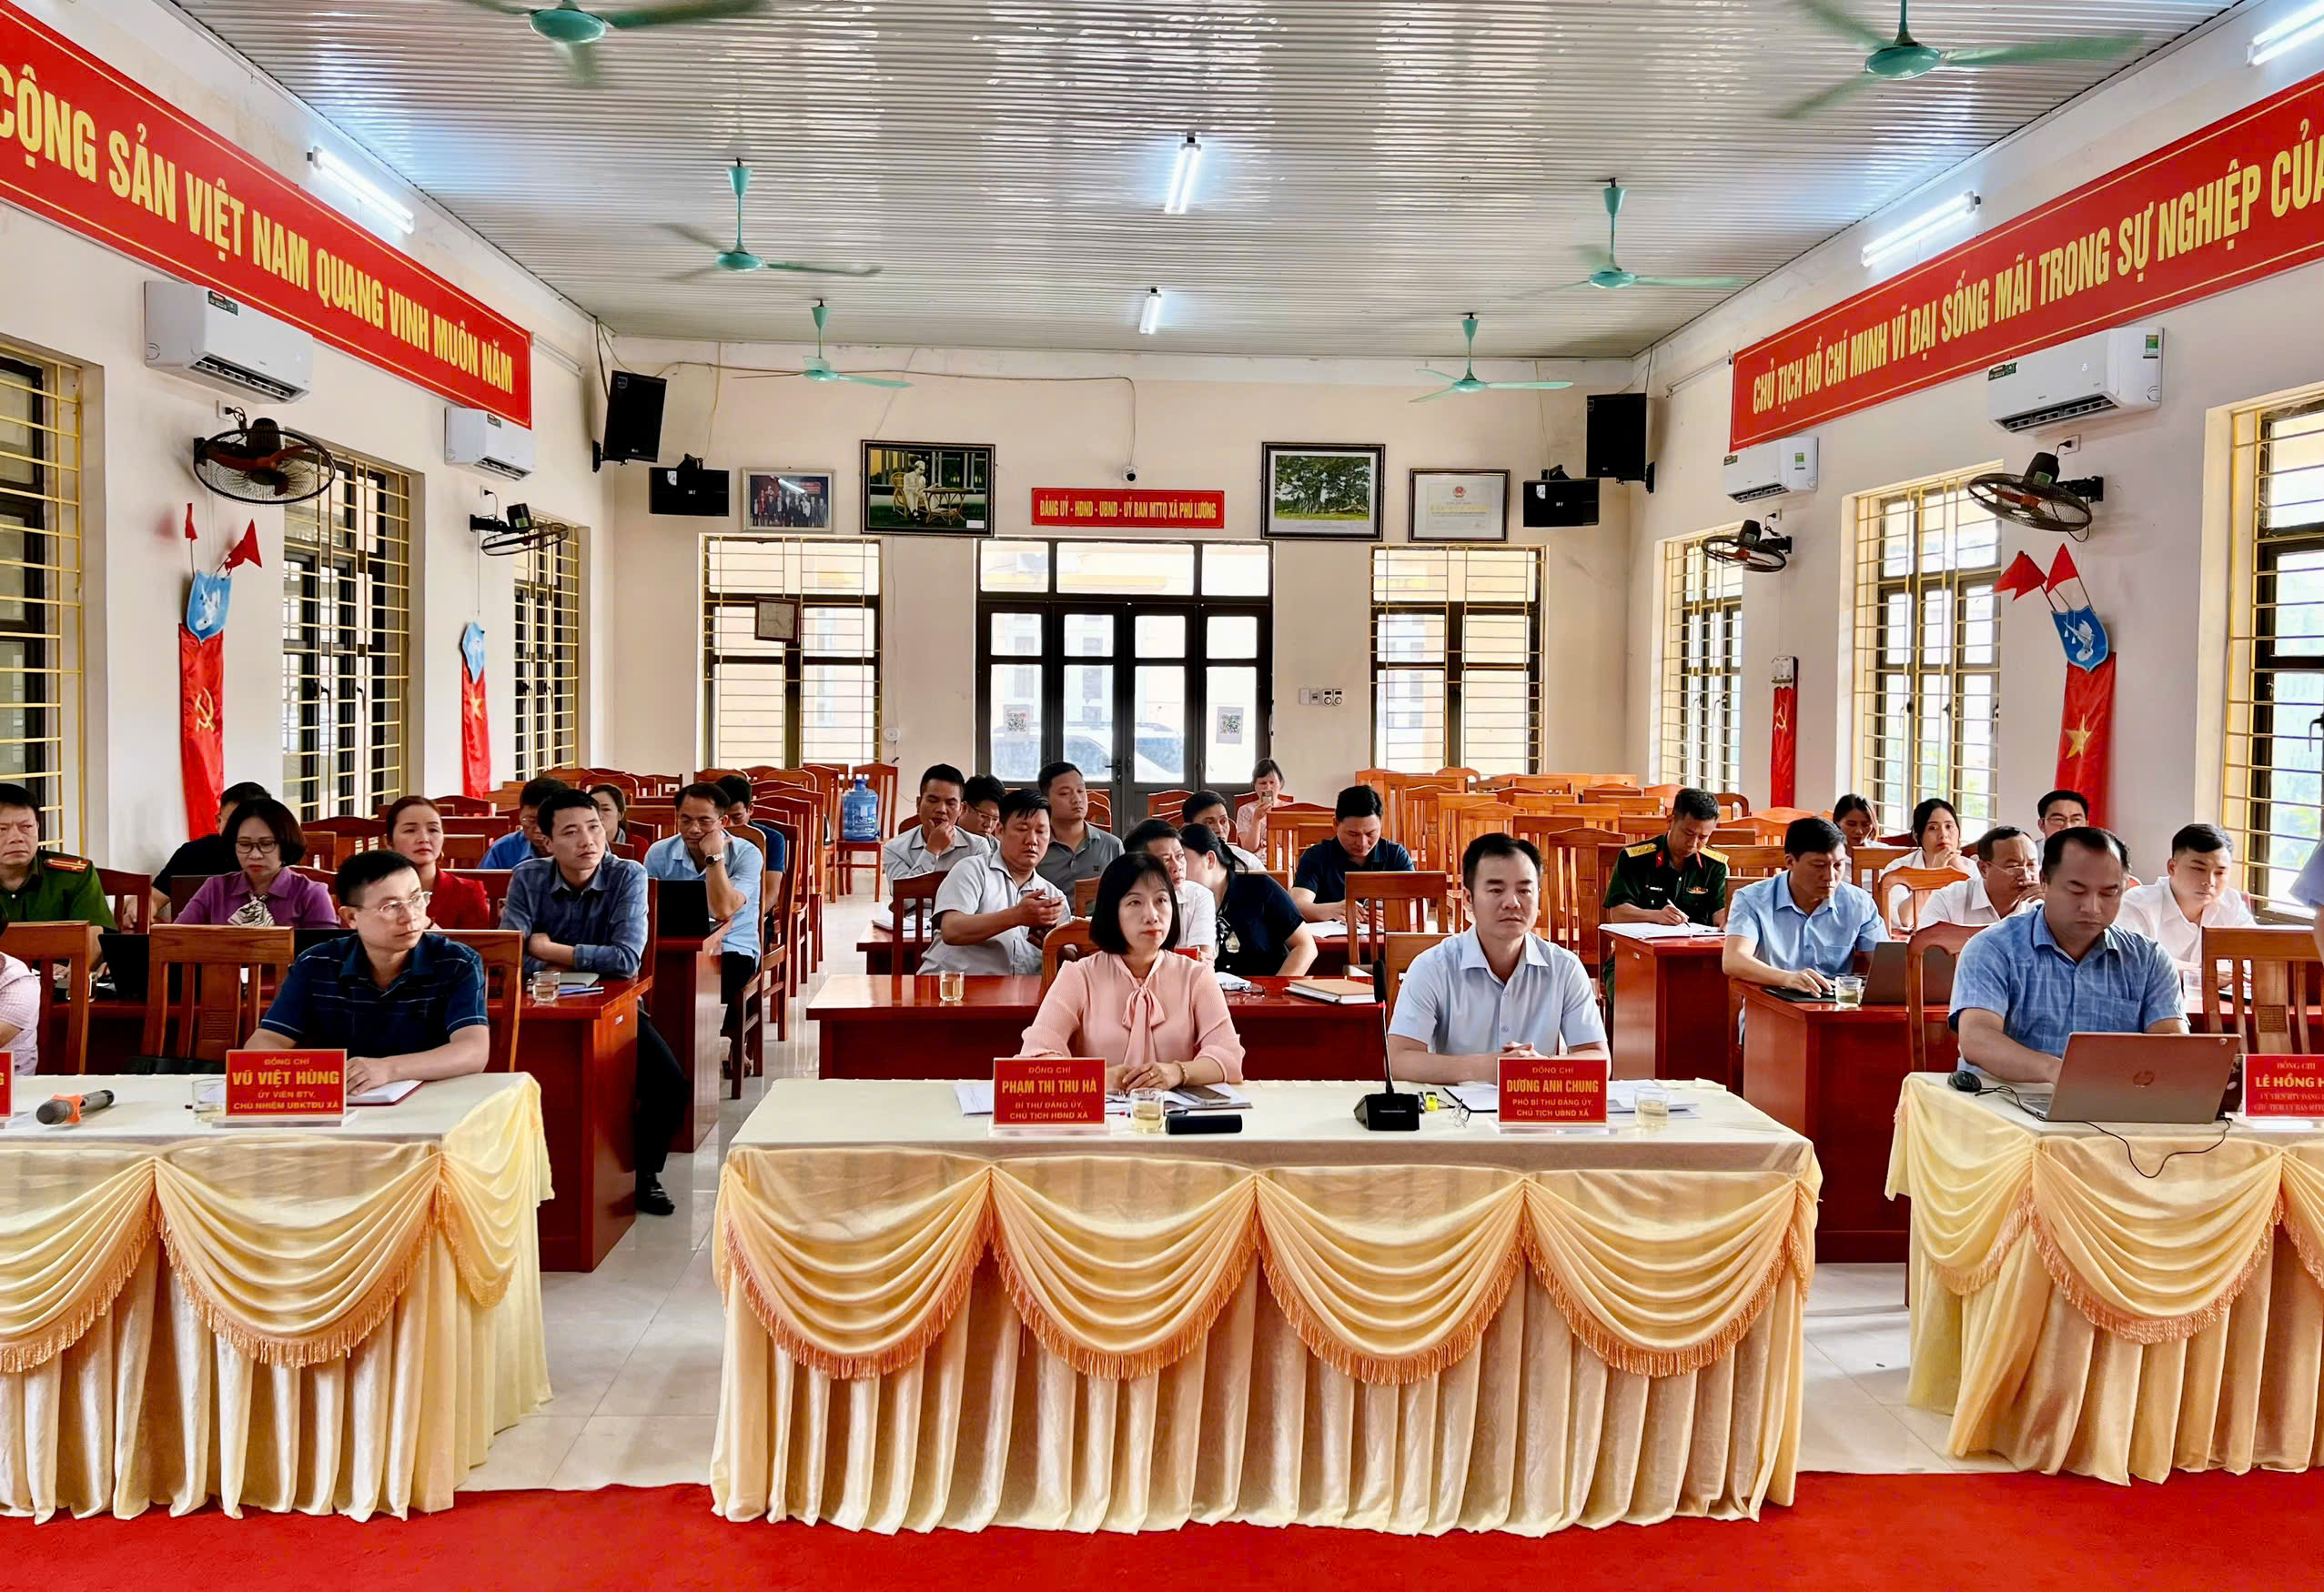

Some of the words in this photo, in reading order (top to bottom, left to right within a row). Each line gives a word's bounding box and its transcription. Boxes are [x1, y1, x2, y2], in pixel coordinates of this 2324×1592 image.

[0, 64, 96, 183] CỘNG
[108, 123, 177, 224] SẢN
[185, 170, 245, 262] VIỆT
[252, 208, 309, 291] NAM
[316, 247, 384, 329] QUANG
[388, 287, 429, 353] VINH
[433, 314, 478, 377] MUÔN
[481, 338, 513, 394] NĂM
[1753, 357, 1775, 414] CHỦ
[1777, 356, 1803, 412] TỊCH
[1804, 336, 1822, 394] HỒ
[1824, 329, 1848, 387] CHÍ
[1850, 320, 1888, 378] MINH
[1892, 304, 1907, 361] VĨ
[1910, 300, 1937, 360] ĐẠI
[1941, 269, 1990, 343] SỐNG
[1995, 255, 2033, 323] MÃI
[2038, 227, 2110, 306] TRONG
[2117, 201, 2155, 283] SỰ
[2157, 158, 2261, 262] NGHIỆP
[1040, 495, 1058, 517] ĐẢNG
[1099, 501, 1118, 518] UBND
[1134, 501, 1147, 518] BAN
[1149, 502, 1167, 519] MTTQ
[1168, 499, 1178, 519] XÃ
[232, 1069, 253, 1085] VŨ
[258, 1069, 291, 1088] VIỆT
[296, 1069, 340, 1085] HÙNG
[1002, 1079, 1035, 1097] PHẠM
[1038, 1079, 1056, 1096] THỊ
[1058, 1080, 1078, 1093] THU
[1082, 1076, 1097, 1093] HÀ
[1506, 1078, 1541, 1093] DƯƠNG
[1542, 1079, 1562, 1093] ANH
[1565, 1079, 1599, 1093] CHUNG
[2256, 1073, 2270, 1087] LÊ
[2274, 1072, 2315, 1087] HỒNG
[1026, 1101, 1043, 1109] THƯ
[1516, 1108, 1533, 1117] CHỦ
[1536, 1110, 1553, 1118] TỊCH
[1009, 1110, 1027, 1120] CHỦ
